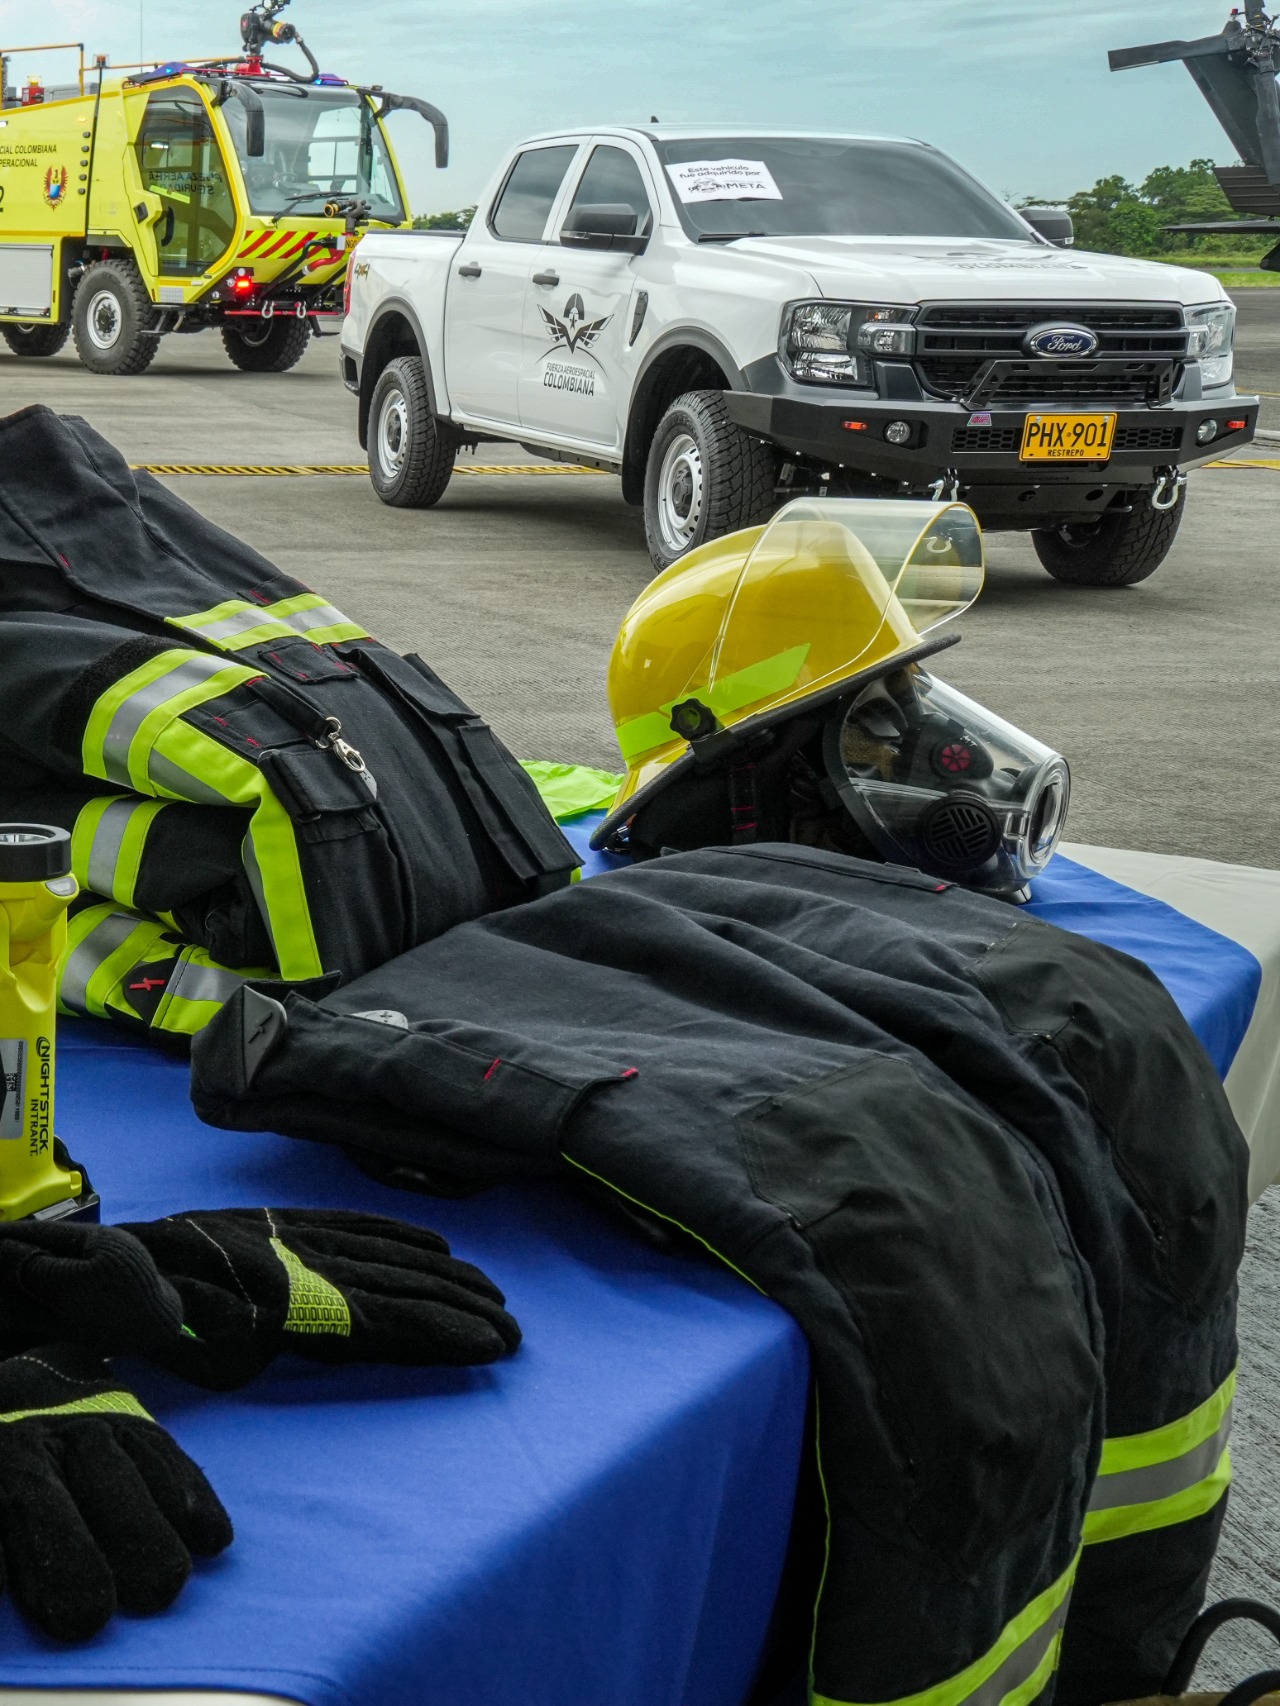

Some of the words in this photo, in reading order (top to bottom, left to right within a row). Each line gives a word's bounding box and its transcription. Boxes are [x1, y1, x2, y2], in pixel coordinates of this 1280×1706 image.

[14, 144, 57, 155] COLOMBIANA
[726, 182, 767, 190] META
[1046, 334, 1082, 351] Ford
[546, 362, 564, 374] FUERZA
[563, 365, 596, 380] AEROESPACIAL
[543, 371, 595, 397] COLOMBIANA
[1047, 448, 1085, 457] RESTREPO
[39, 1044, 51, 1152] NIGHTSTICK
[29, 1098, 39, 1157] INTRANT
